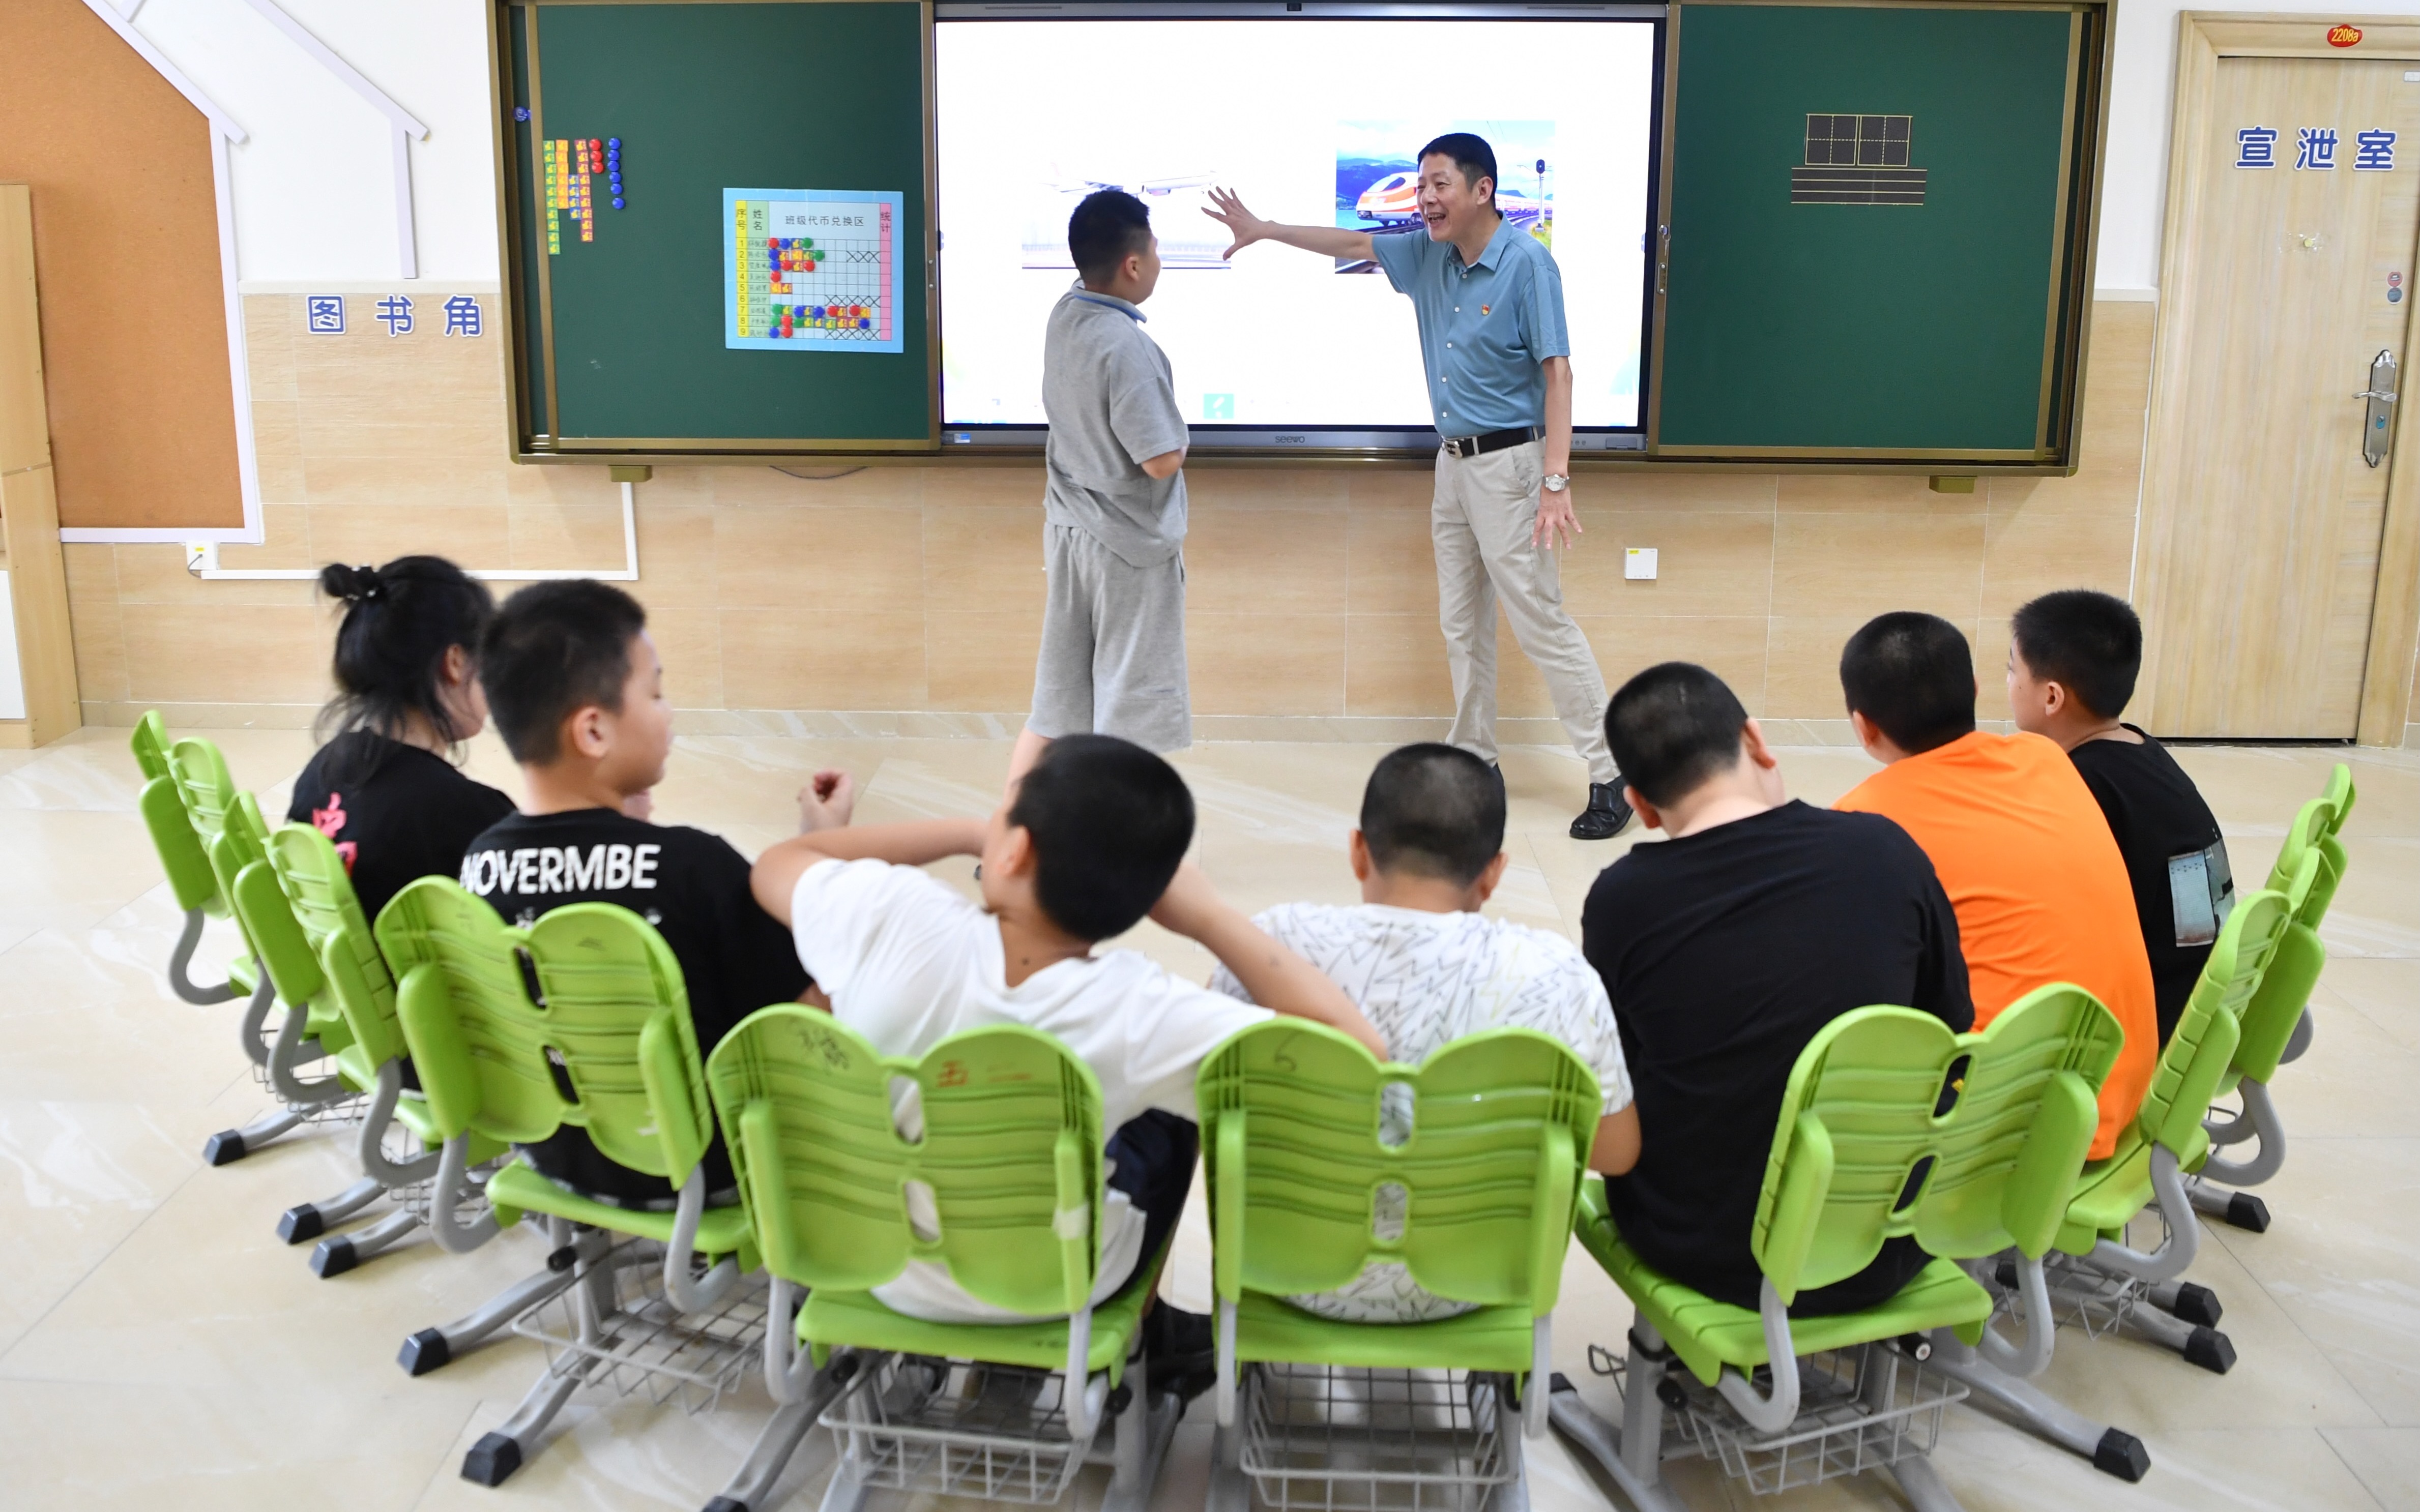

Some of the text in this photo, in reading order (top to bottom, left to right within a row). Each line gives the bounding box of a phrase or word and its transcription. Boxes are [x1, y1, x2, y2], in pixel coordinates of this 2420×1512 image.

[2331, 28, 2359, 42] 2208a
[2236, 127, 2396, 169] 宣泄室
[736, 209, 747, 230] 序号
[753, 209, 763, 230] 姓名
[785, 215, 864, 227] 班级代币兑换区
[880, 212, 891, 232] 统计
[308, 295, 481, 336] 图书角
[459, 844, 661, 896] NOVERMBE
